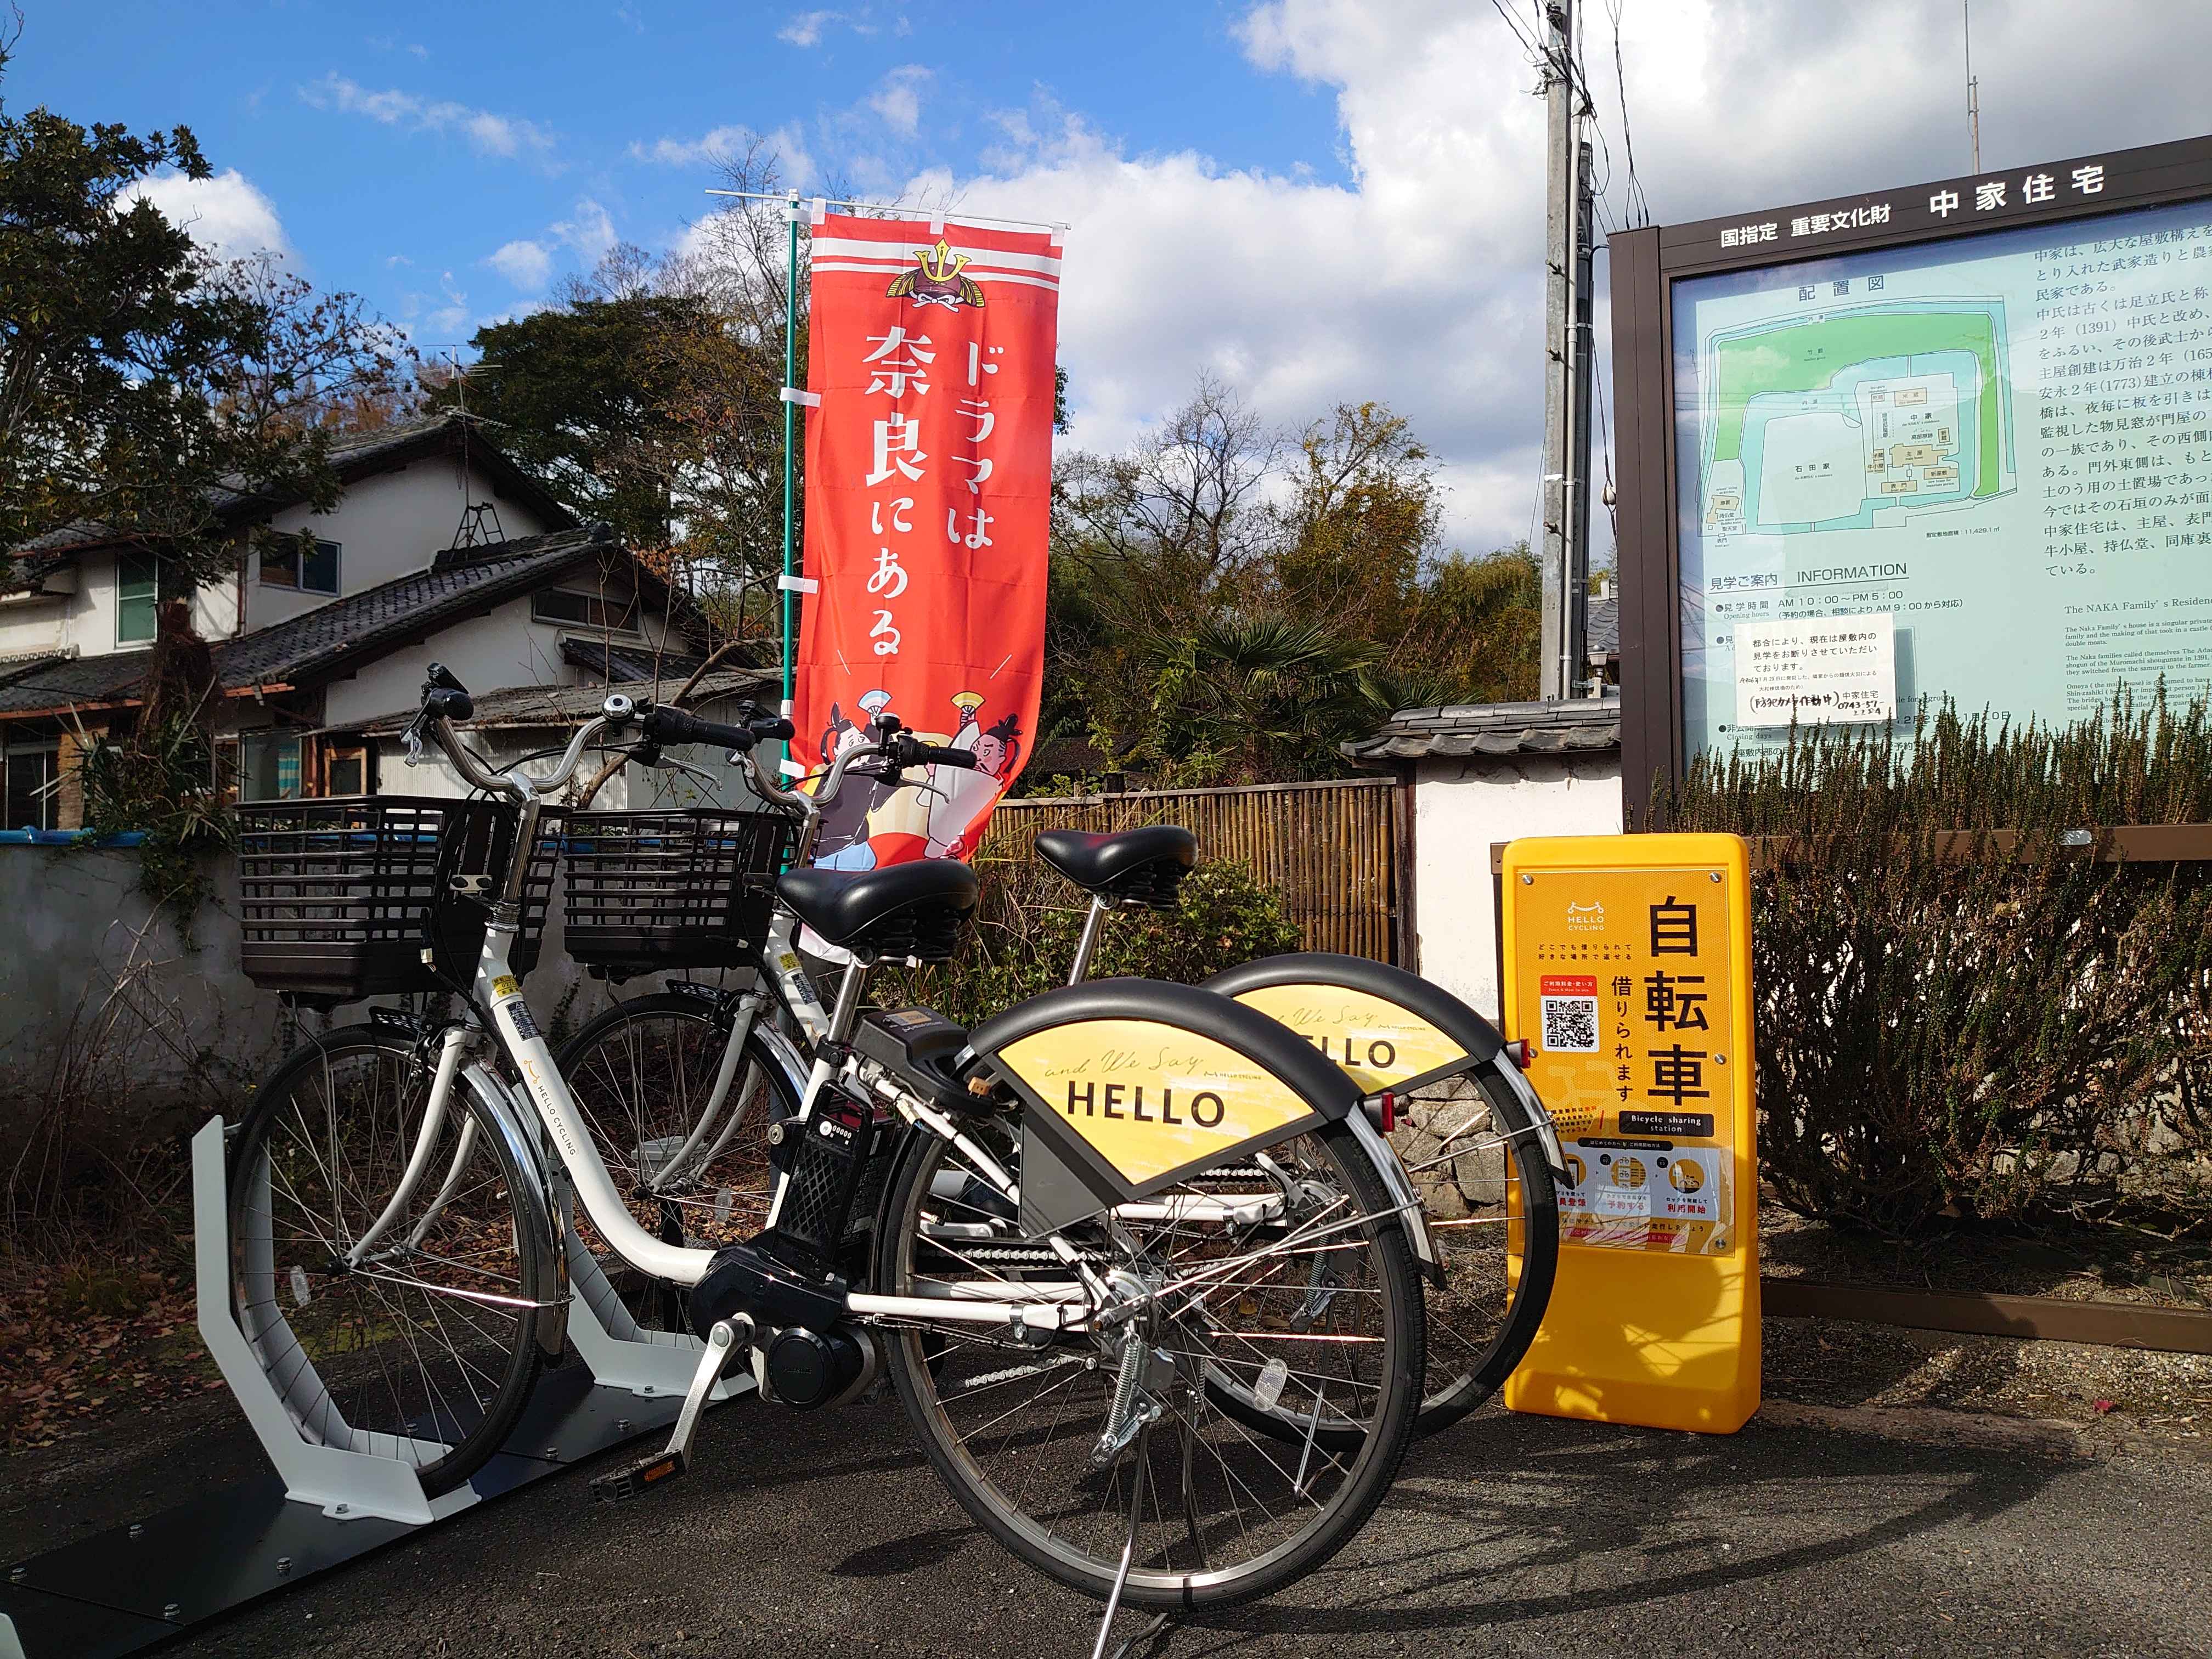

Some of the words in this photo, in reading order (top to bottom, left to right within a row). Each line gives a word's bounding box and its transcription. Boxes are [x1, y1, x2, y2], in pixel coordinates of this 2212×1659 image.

[1720, 223, 1778, 248] 国指定
[1791, 204, 1891, 237] 重要文化財
[1929, 165, 2104, 218] 中家住宅
[1798, 275, 1884, 302] 配置図
[2036, 281, 2115, 302] 民家である。
[2036, 286, 2208, 321] 中氏は古くは足立氏と称
[1910, 413, 1932, 421] 中家
[2040, 388, 2211, 420] 橋は、夜毎に板を引きは
[946, 339, 1005, 549] ドラマは
[2041, 430, 2212, 458] の一族であり、その西側
[1795, 462, 1830, 472] 石田家
[2042, 450, 2211, 479] ある。門外東側は、もと
[862, 326, 938, 656] 奈良にある
[2042, 472, 2212, 499] 土のう用の土置場であっ
[2043, 490, 2212, 518] 今ではその石垣のみが面
[2044, 532, 2211, 558] 牛小屋、持仏堂、同庫裏
[1710, 573, 1778, 591] 見学ご案内
[1797, 563, 1908, 583] INFORMATION
[2045, 562, 2096, 577] ている。
[1724, 600, 1769, 612] 見学時間
[2064, 605, 2083, 614] The
[2086, 603, 2119, 613] NAKA
[1753, 633, 1877, 647] 都合により、現在は屋敷内の
[1753, 645, 1877, 661] 見学をお断りさせていただい
[1753, 662, 1804, 673] ております。
[2109, 658, 2145, 666] Muromachi
[1842, 690, 1879, 700] 中家住宅
[1644, 895, 1710, 1106] 自転車
[1293, 1007, 1326, 1026] We
[1332, 1005, 1379, 1028] Say
[1611, 975, 1633, 1102] 借りられます
[1045, 1058, 1091, 1077] and
[1101, 1049, 1141, 1074] We
[1148, 1046, 1205, 1075] Say
[1068, 1080, 1225, 1128] HELLO
[538, 1085, 556, 1115] HELLO
[554, 1117, 576, 1155] CYCLING
[1631, 1115, 1663, 1124] Bicycle
[1668, 1117, 1701, 1127] sharing
[1667, 1204, 1706, 1214] 利用開始
